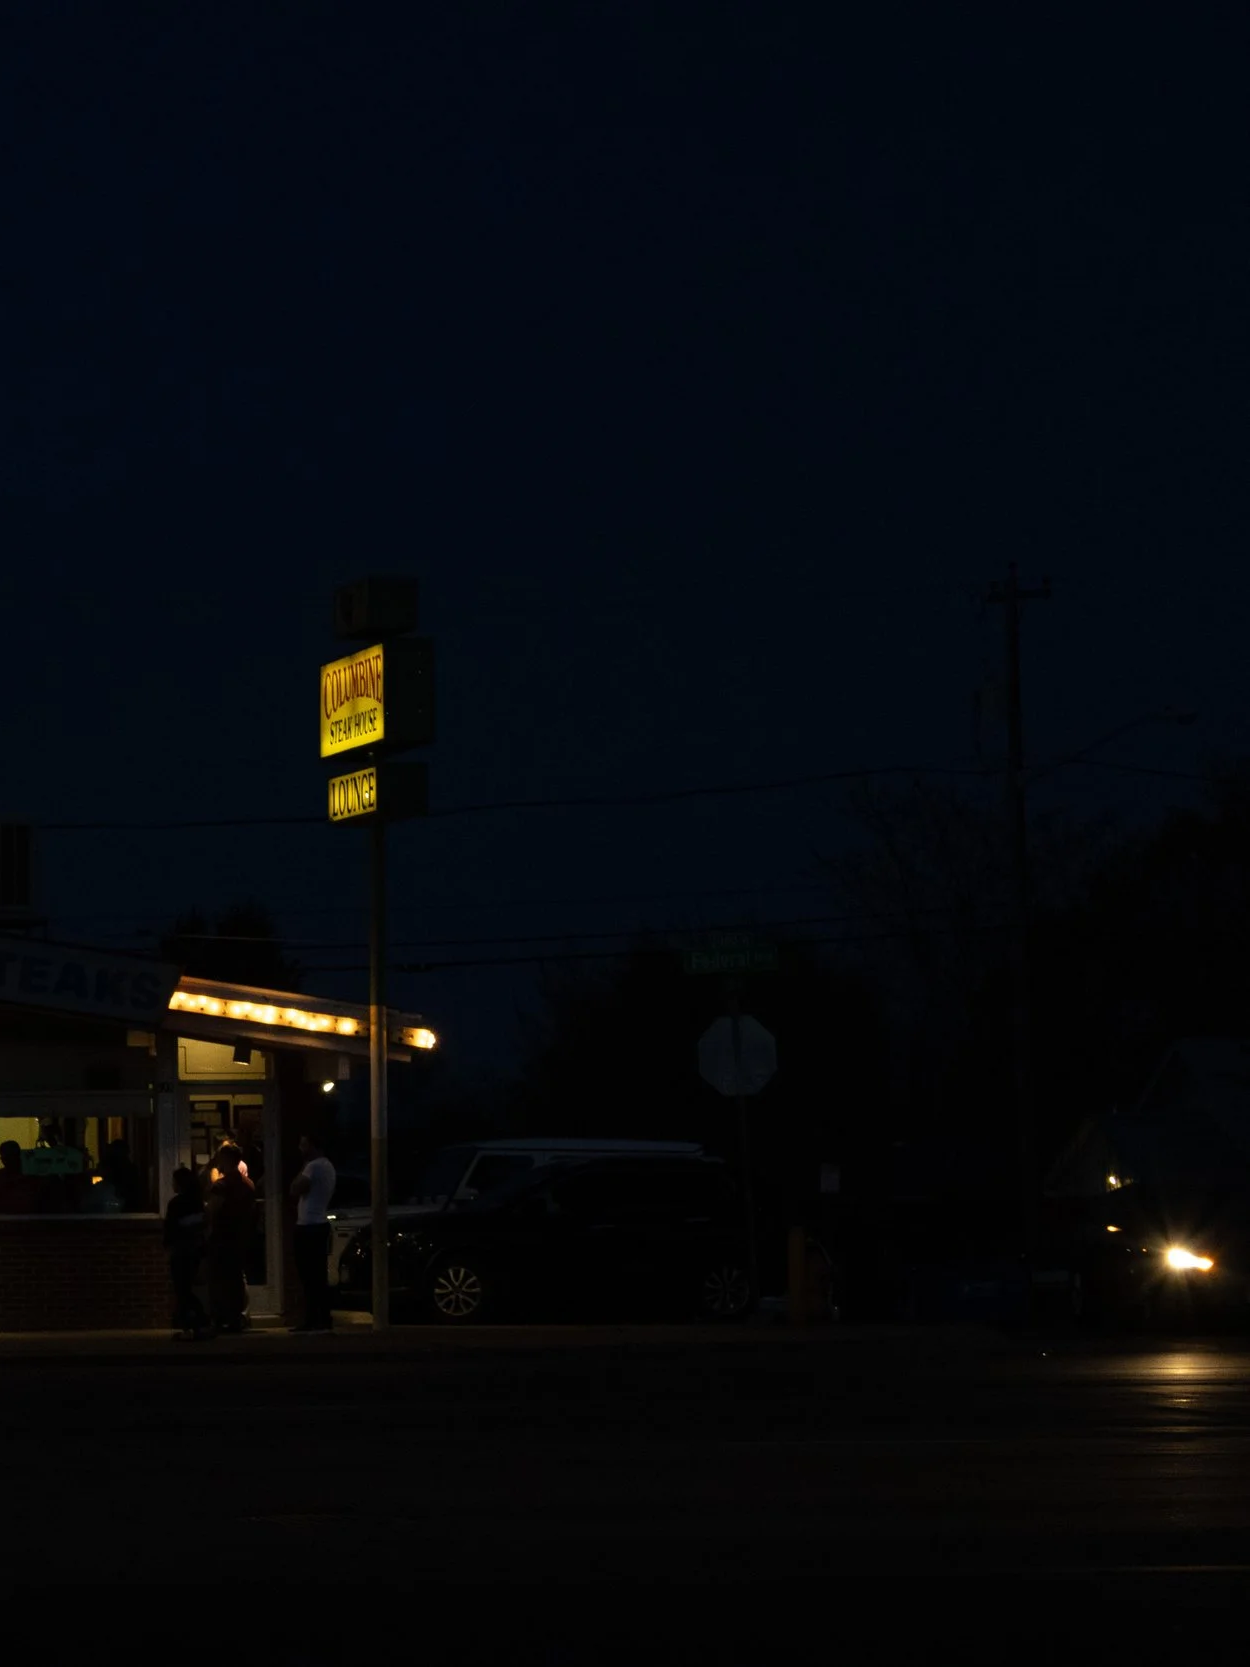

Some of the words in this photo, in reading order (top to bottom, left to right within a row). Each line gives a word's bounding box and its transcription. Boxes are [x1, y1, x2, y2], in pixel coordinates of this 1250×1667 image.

[324, 654, 383, 720] COLUMBINE
[329, 714, 353, 745] STEAK
[354, 707, 378, 738] HOUSE
[331, 772, 375, 817] LOUNGE
